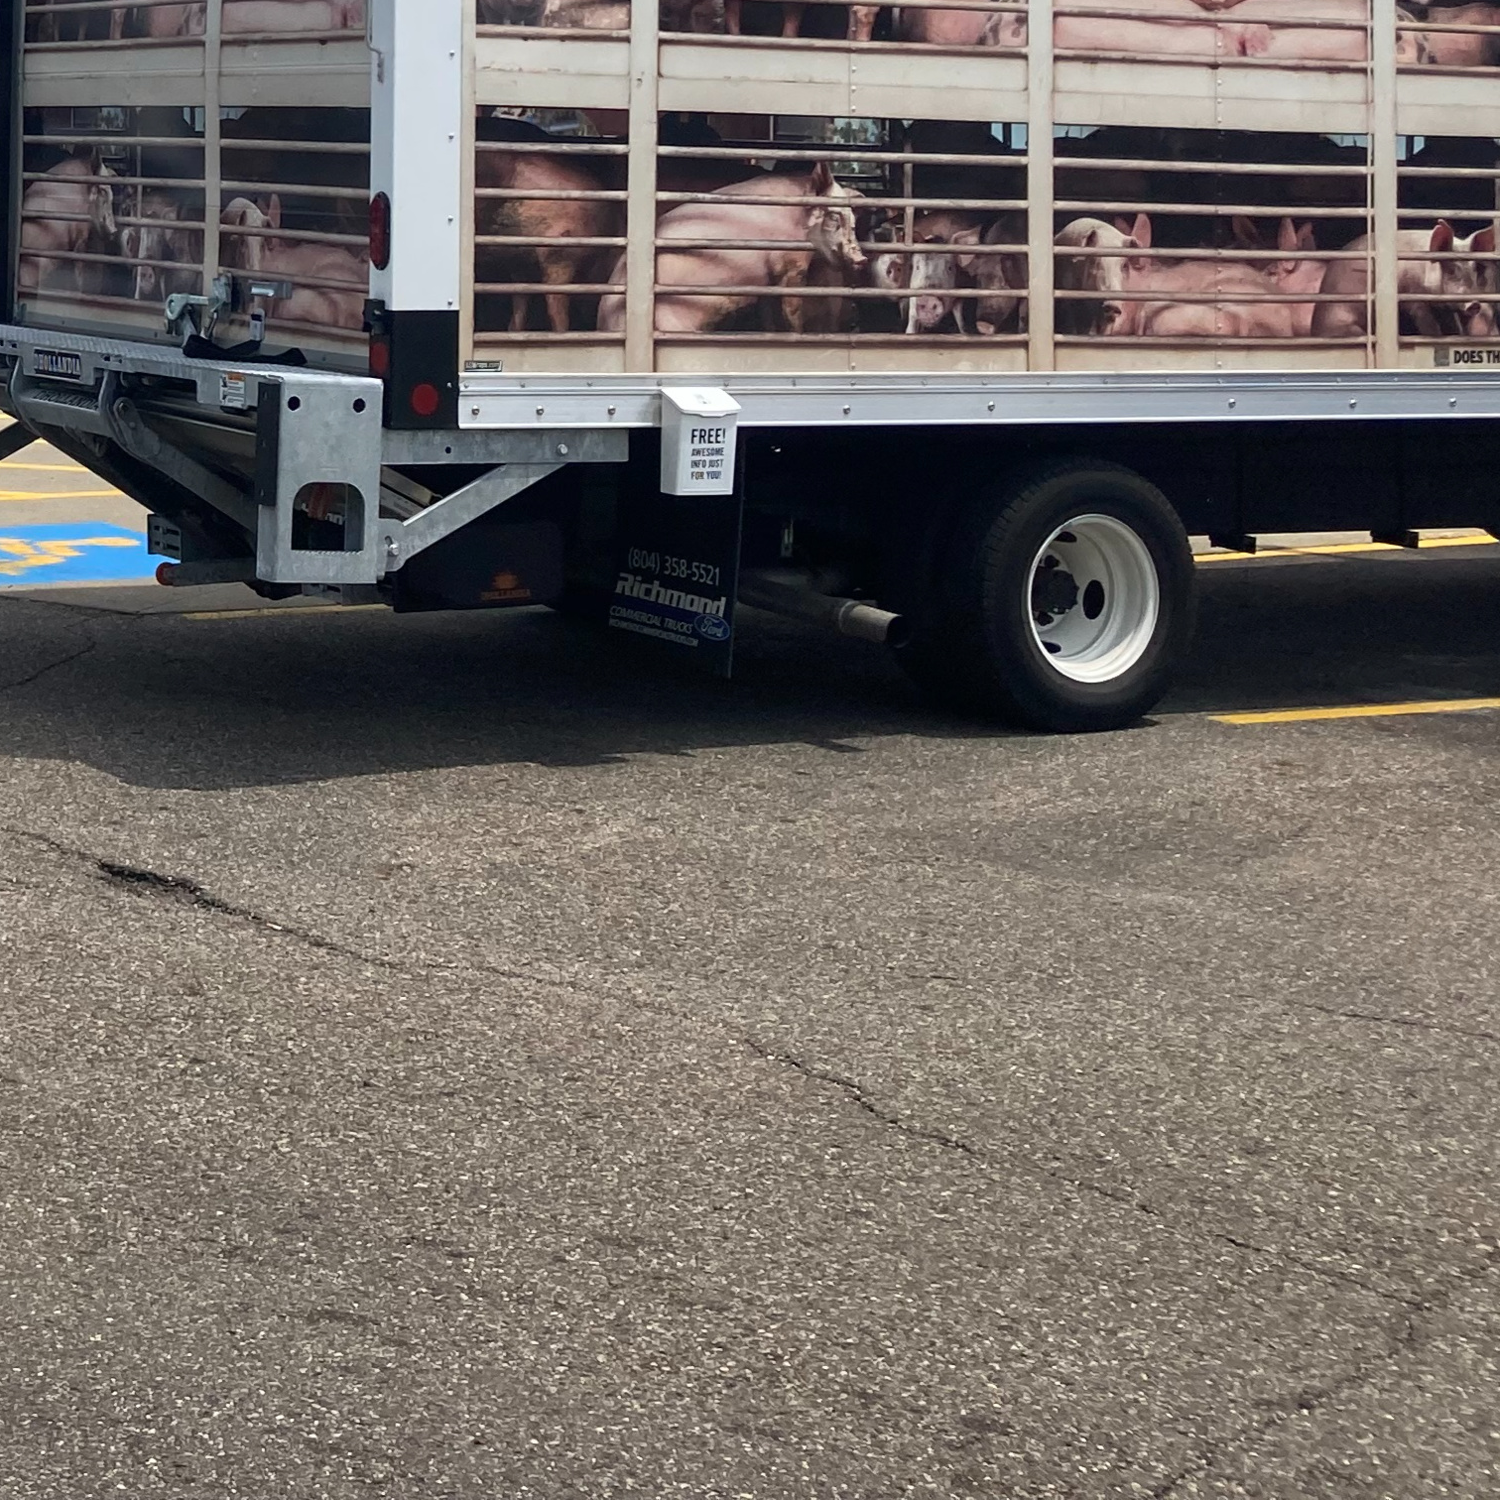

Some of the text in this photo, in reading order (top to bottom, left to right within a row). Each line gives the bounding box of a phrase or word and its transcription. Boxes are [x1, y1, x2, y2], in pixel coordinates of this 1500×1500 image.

[1453, 350, 1484, 364] DOES
[691, 428, 726, 444] FREE!
[691, 447, 725, 457] AWESOME
[691, 459, 724, 468] INFO JUST
[628, 546, 720, 587] (804) 358-5521
[614, 572, 727, 619] Richmond
